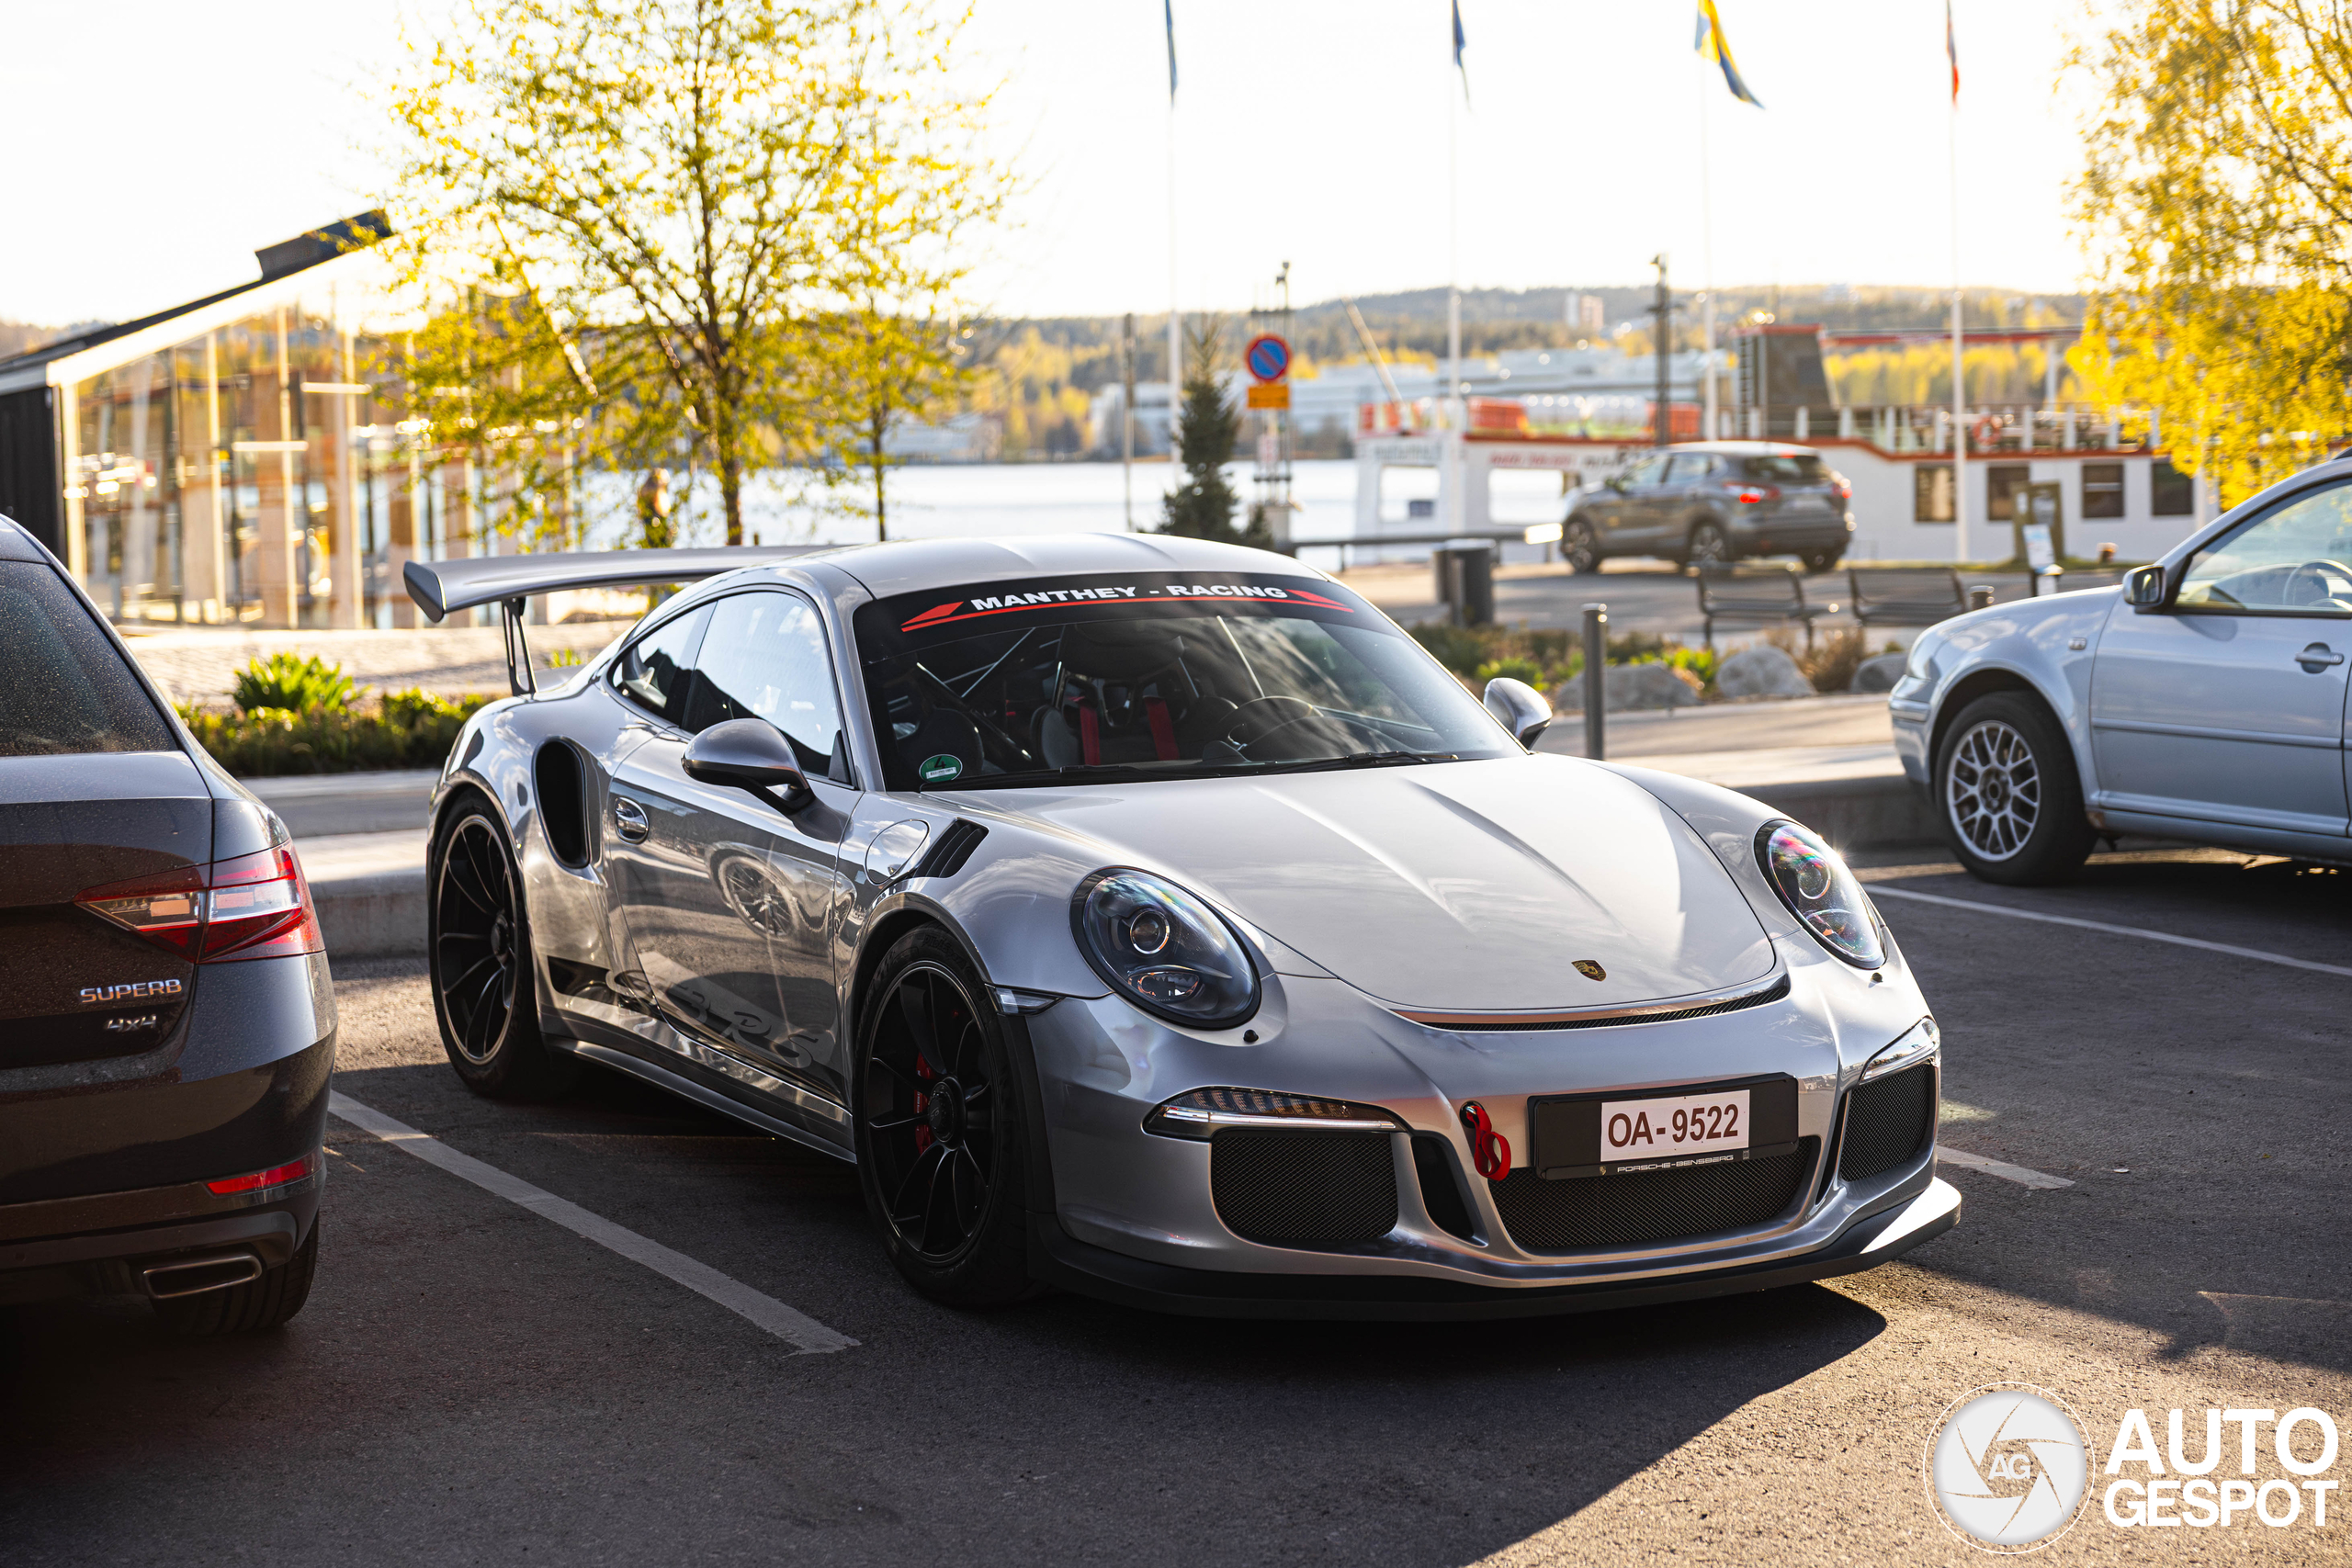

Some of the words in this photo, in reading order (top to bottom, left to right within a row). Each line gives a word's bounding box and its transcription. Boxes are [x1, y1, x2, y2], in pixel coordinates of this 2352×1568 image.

[970, 586, 1137, 612] MANTHEY
[1165, 584, 1289, 600] RACING
[933, 756, 946, 768] 4
[80, 978, 182, 1003] SUPERB
[107, 1015, 157, 1032] 4x4
[1608, 1103, 1739, 1148] OA-9522
[1617, 1155, 1734, 1173] PORSCHE-BENSBERG
